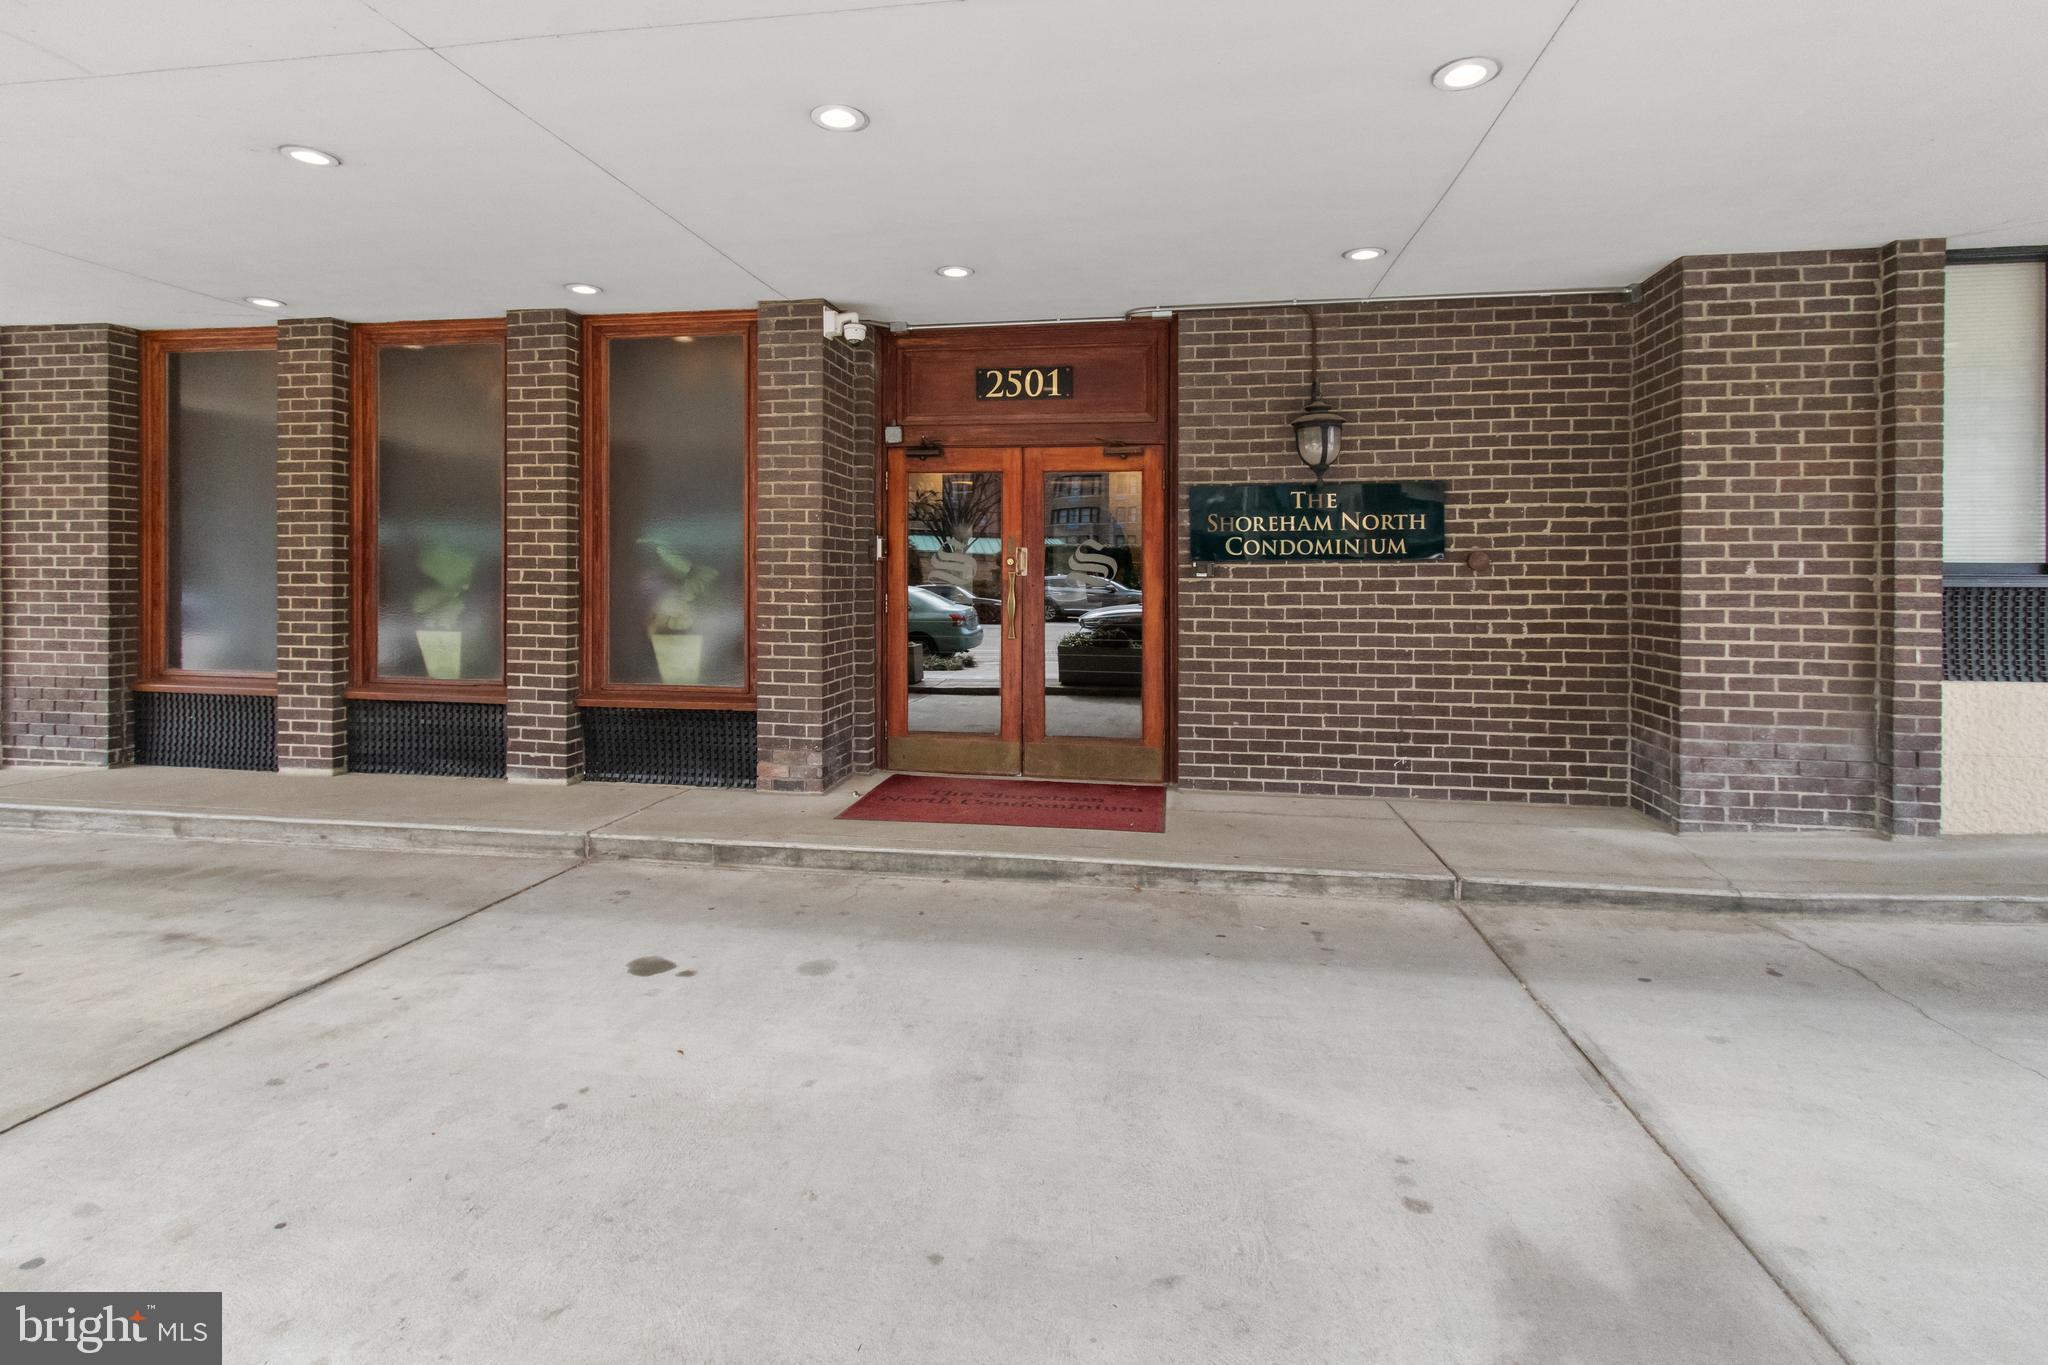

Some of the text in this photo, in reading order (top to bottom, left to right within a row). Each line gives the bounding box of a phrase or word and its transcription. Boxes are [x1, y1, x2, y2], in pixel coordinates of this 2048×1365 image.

[985, 368, 1062, 398] 2501
[1290, 490, 1338, 510] THE
[1206, 511, 1427, 533] SHOREHAM NORTH
[1225, 535, 1408, 556] CONDOMINIUM
